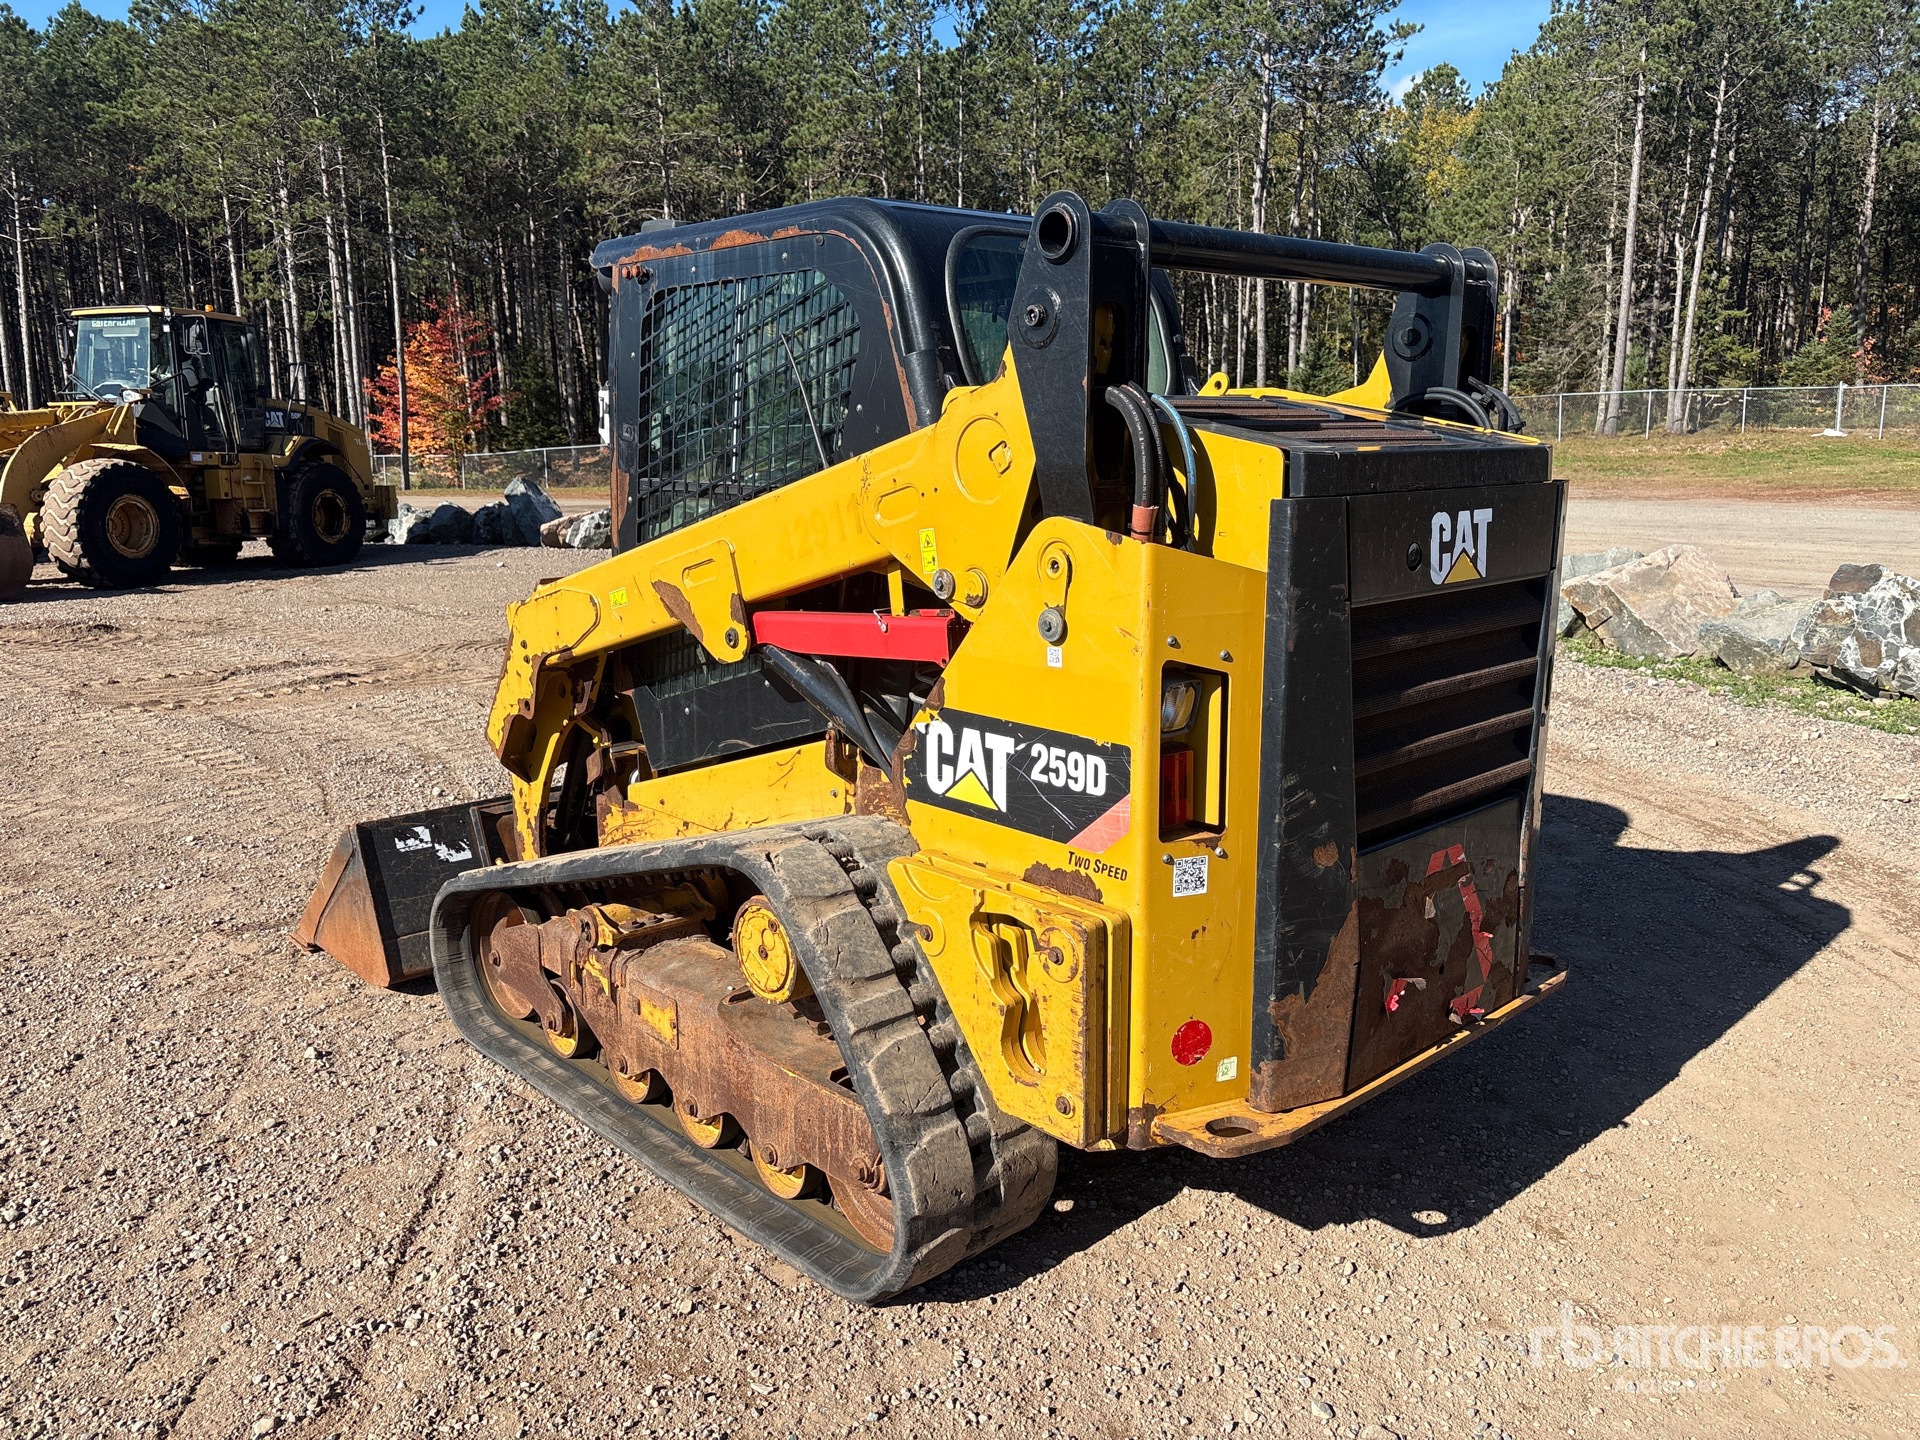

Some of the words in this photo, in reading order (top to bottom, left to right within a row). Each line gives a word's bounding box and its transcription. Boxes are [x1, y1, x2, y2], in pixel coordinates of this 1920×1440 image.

[265, 411, 285, 428] CAT
[1430, 508, 1493, 585] CAT
[926, 719, 1014, 813] CAT
[1030, 743, 1107, 797] 259D
